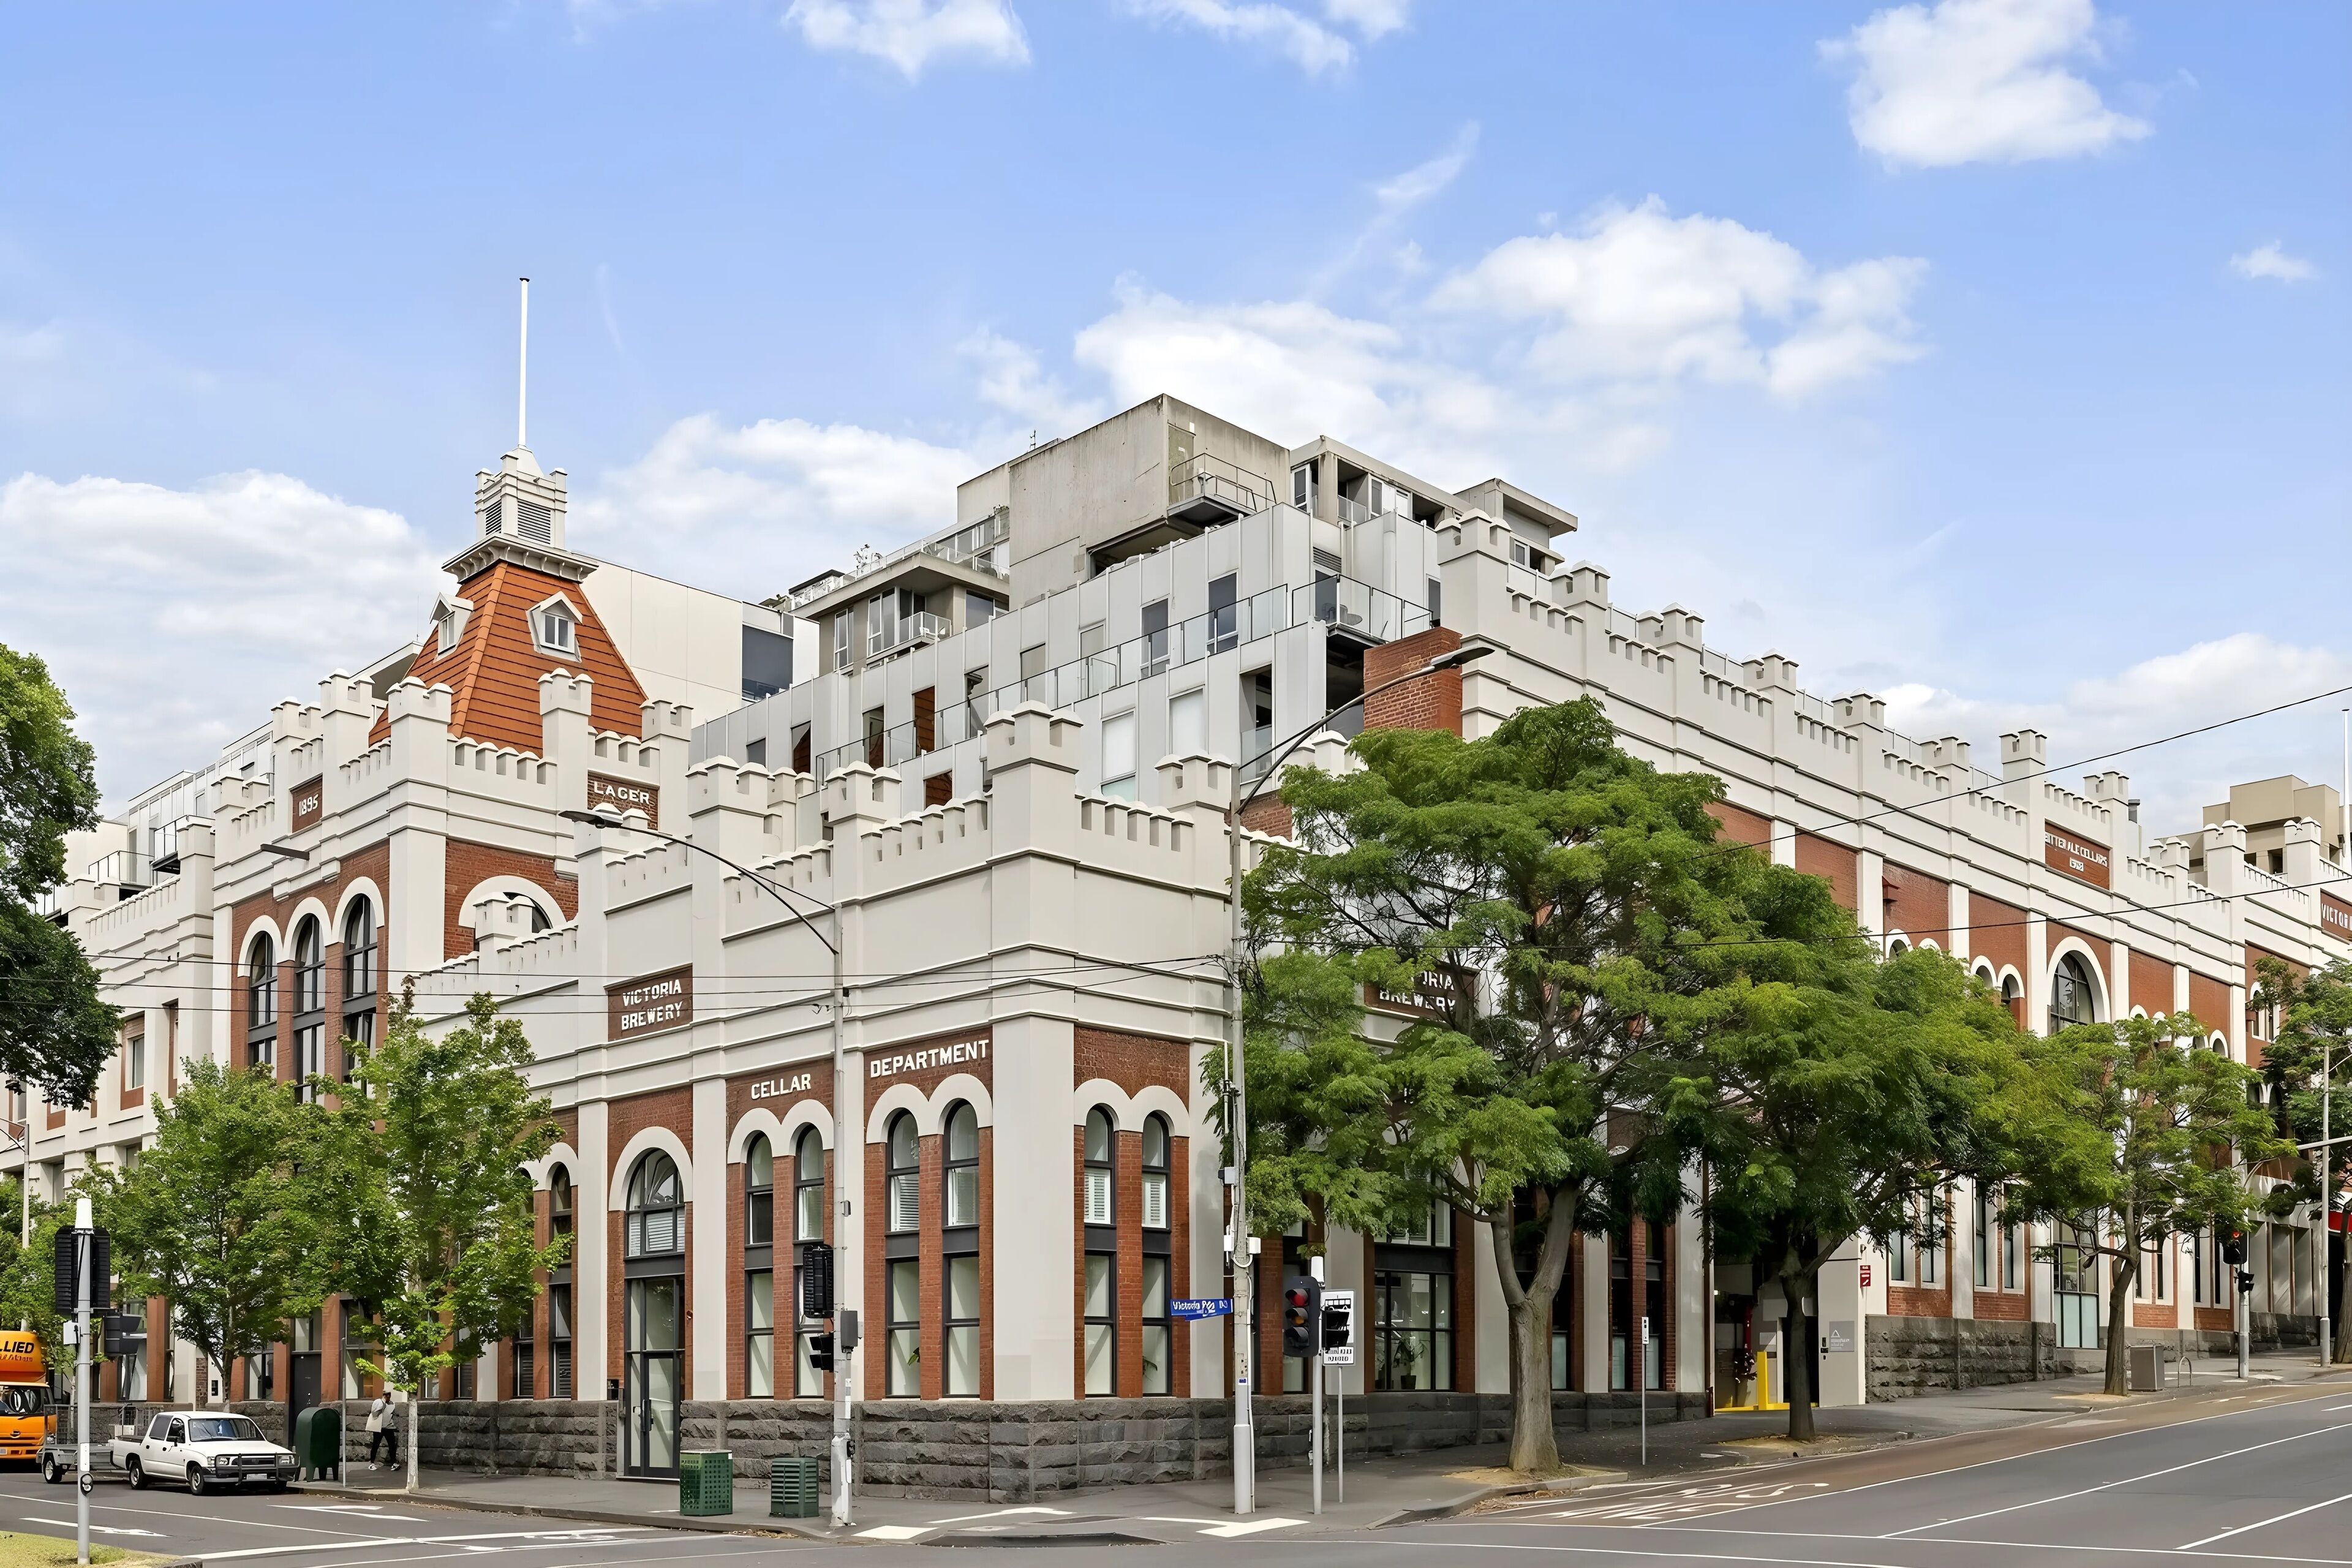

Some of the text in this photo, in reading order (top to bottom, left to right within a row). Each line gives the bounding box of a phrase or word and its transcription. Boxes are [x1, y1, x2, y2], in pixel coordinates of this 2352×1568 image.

[299, 794, 318, 816] 1895
[594, 782, 650, 804] LAGER
[622, 979, 682, 1006] VICTORIA
[621, 1001, 683, 1030] BREWERY
[870, 1039, 989, 1078] DEPARTMENT
[751, 1073, 812, 1099] CELLAR
[0, 1341, 34, 1354] LIED
[1629, 1482, 1829, 1499] BUS
